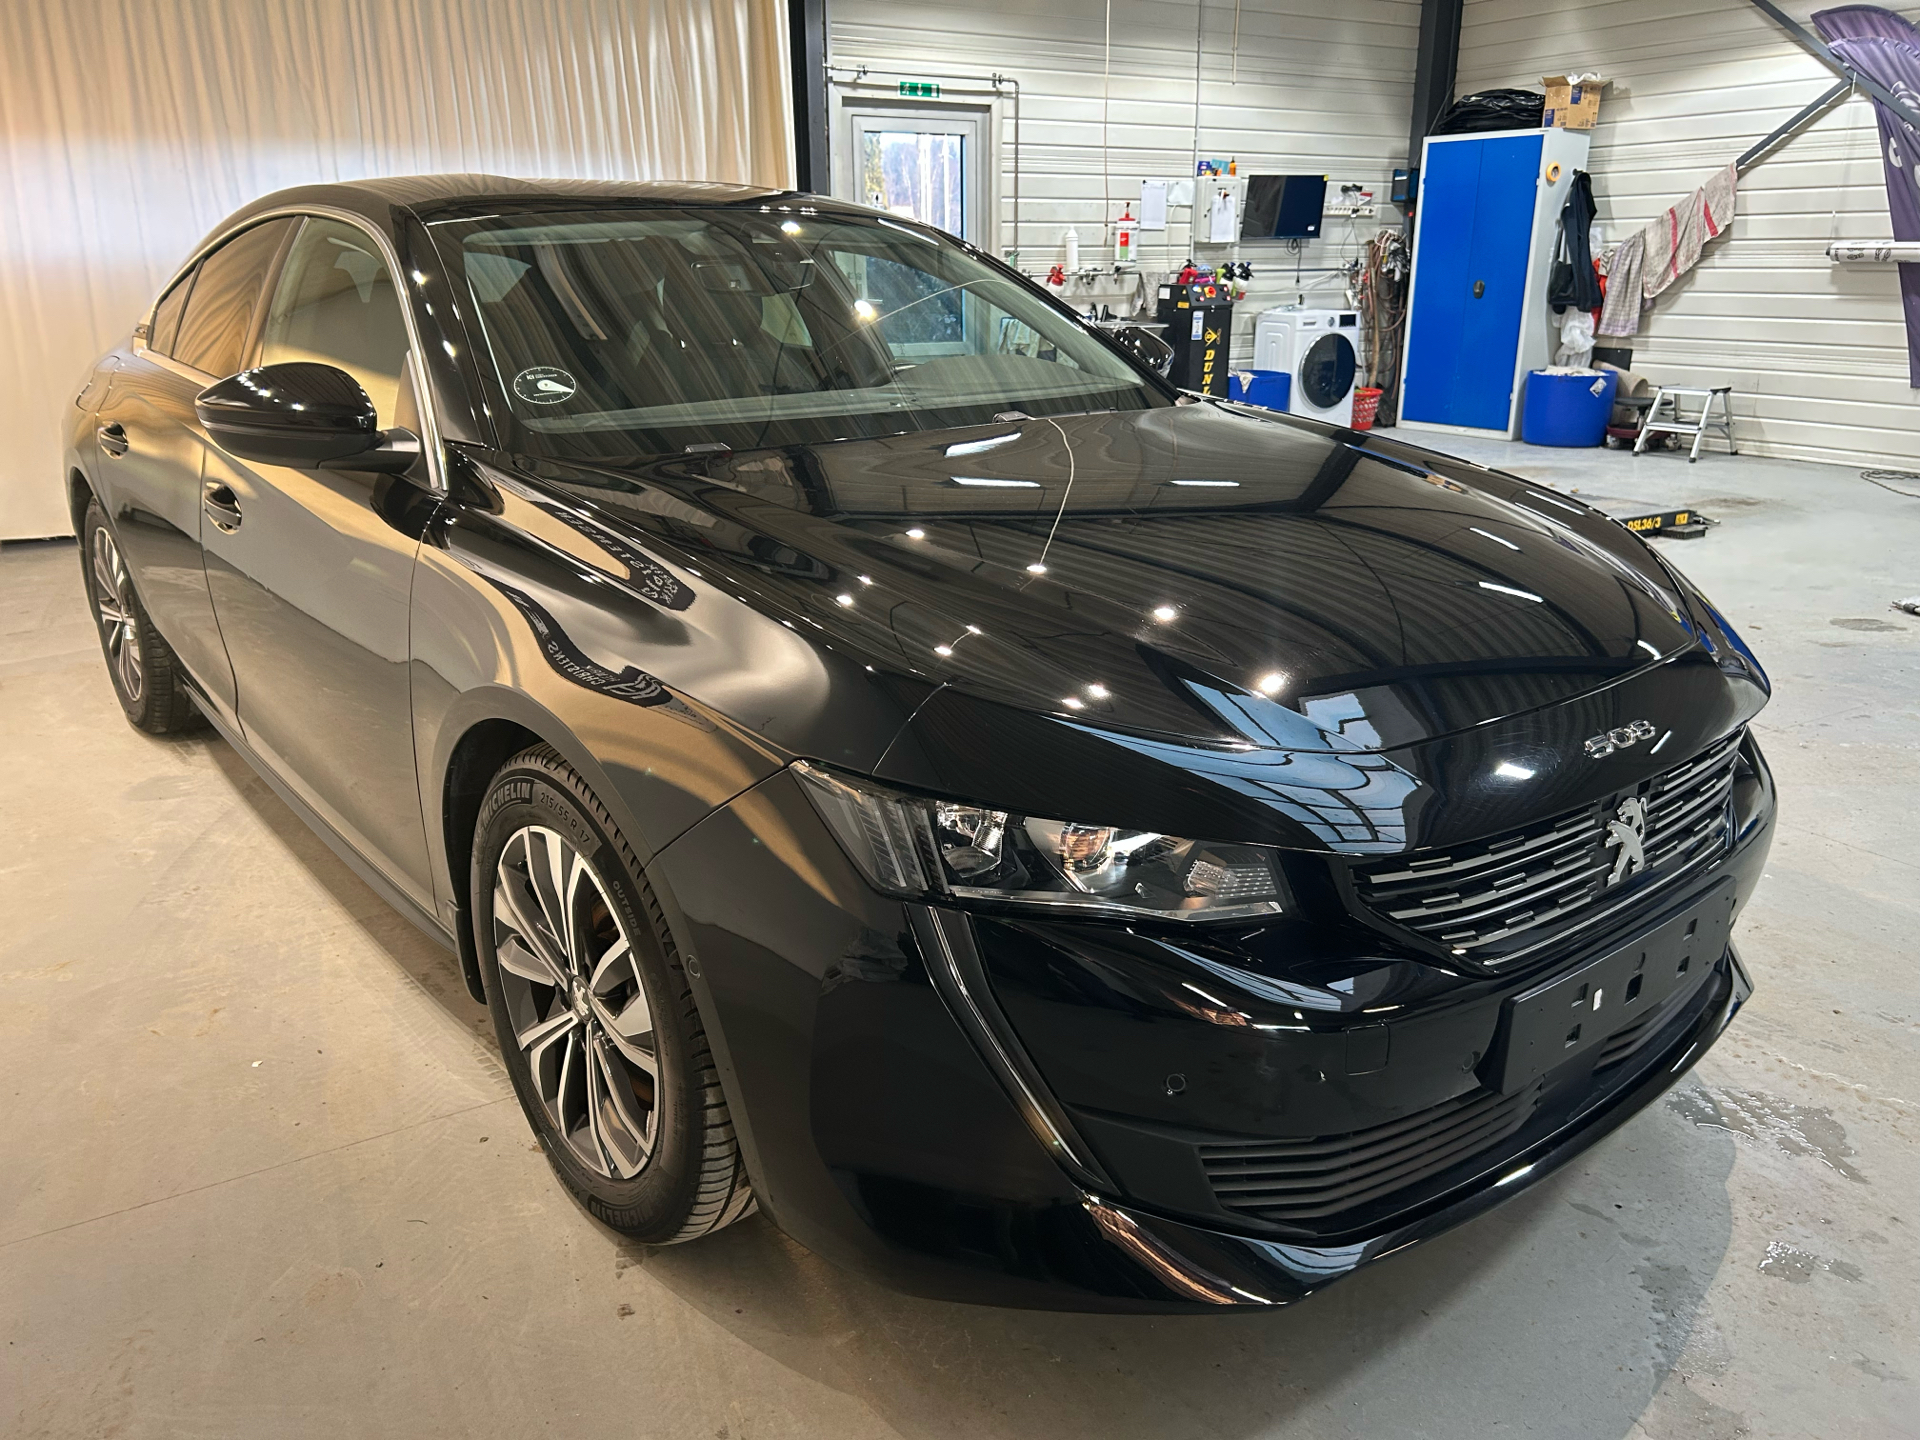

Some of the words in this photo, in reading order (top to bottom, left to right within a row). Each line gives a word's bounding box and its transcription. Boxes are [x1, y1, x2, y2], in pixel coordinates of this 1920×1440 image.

[1202, 349, 1215, 395] DUNL
[1627, 516, 1662, 531] DSL36/3
[1584, 719, 1656, 759] 508
[482, 782, 531, 827] MICHELIN
[540, 792, 570, 821] 215/55
[570, 819, 578, 831] R
[579, 829, 591, 843] 17
[612, 880, 642, 936] OUTSIDE
